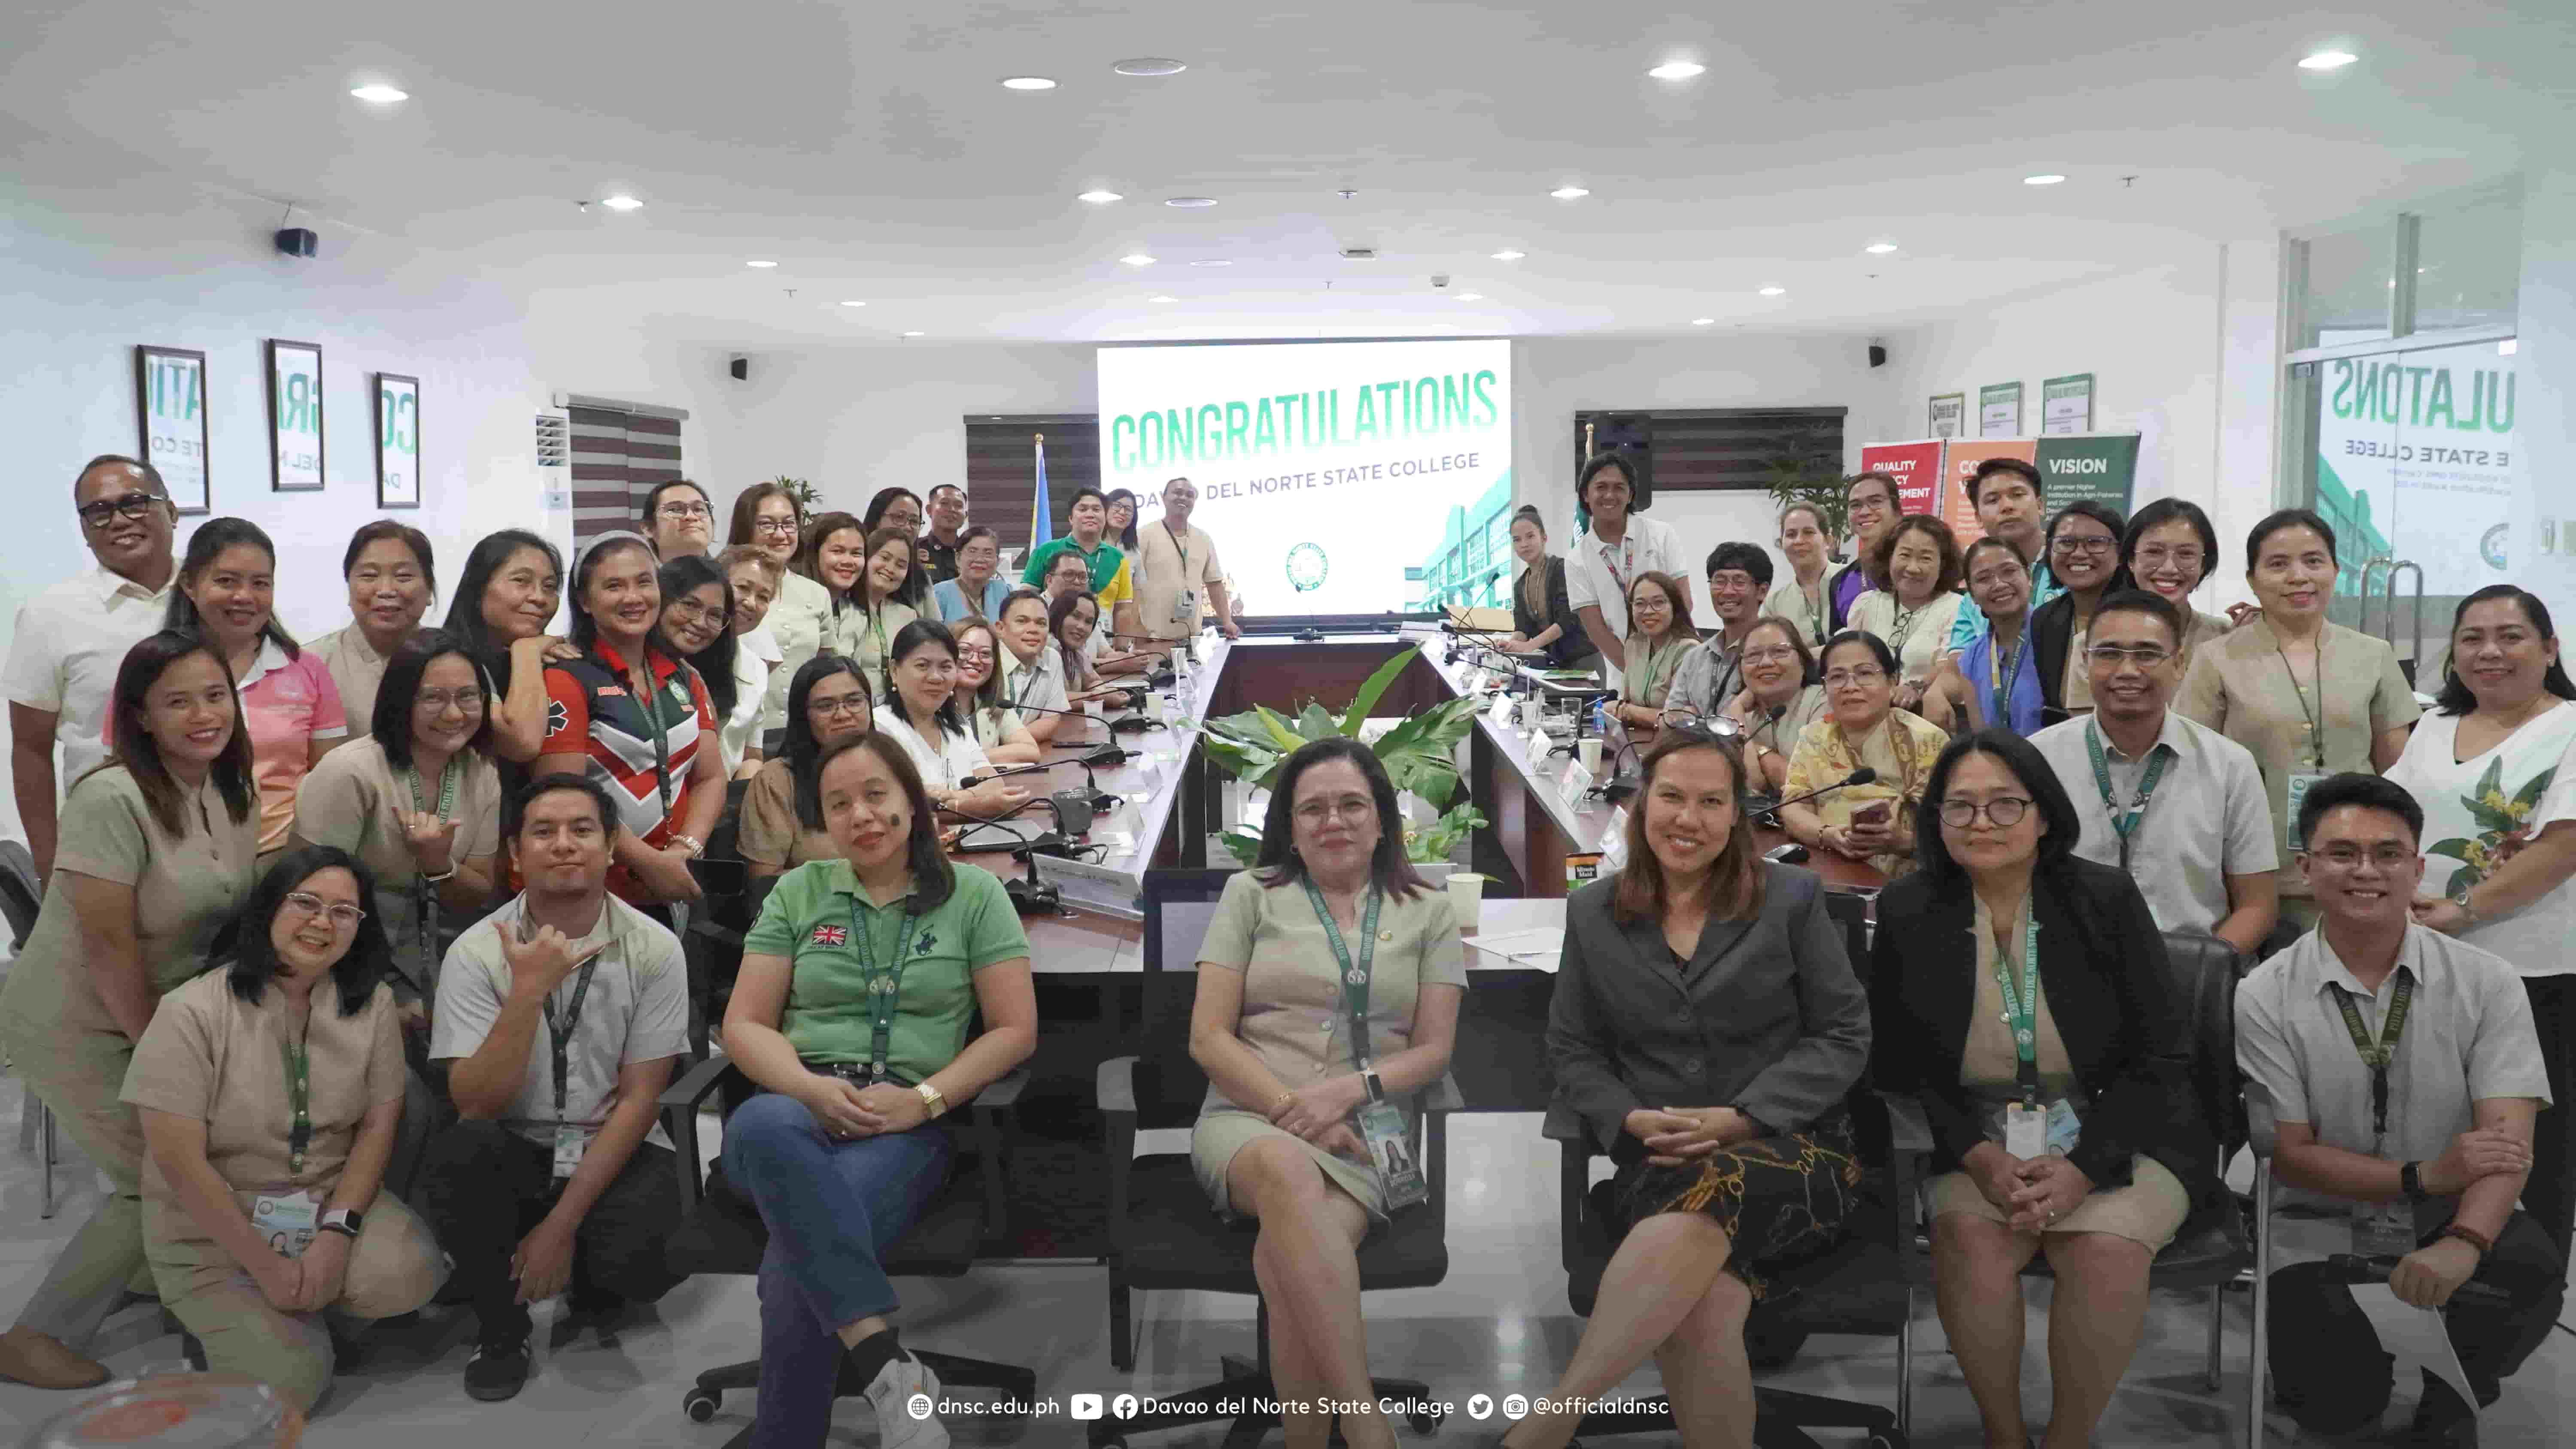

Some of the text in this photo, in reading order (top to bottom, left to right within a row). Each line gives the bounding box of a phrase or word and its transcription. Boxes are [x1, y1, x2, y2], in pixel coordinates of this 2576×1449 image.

[1112, 370, 1497, 473] CONGRATULATIONS
[1206, 482, 1242, 500] DEL
[1250, 474, 1316, 495] NORTE
[1323, 464, 1382, 485] STATE
[1390, 453, 1479, 478] COLLEGE
[1874, 460, 1917, 472] QUALITY
[2049, 458, 2107, 474] VISION
[2025, 976, 2035, 988] DEL
[2023, 989, 2034, 1015] DAVAO
